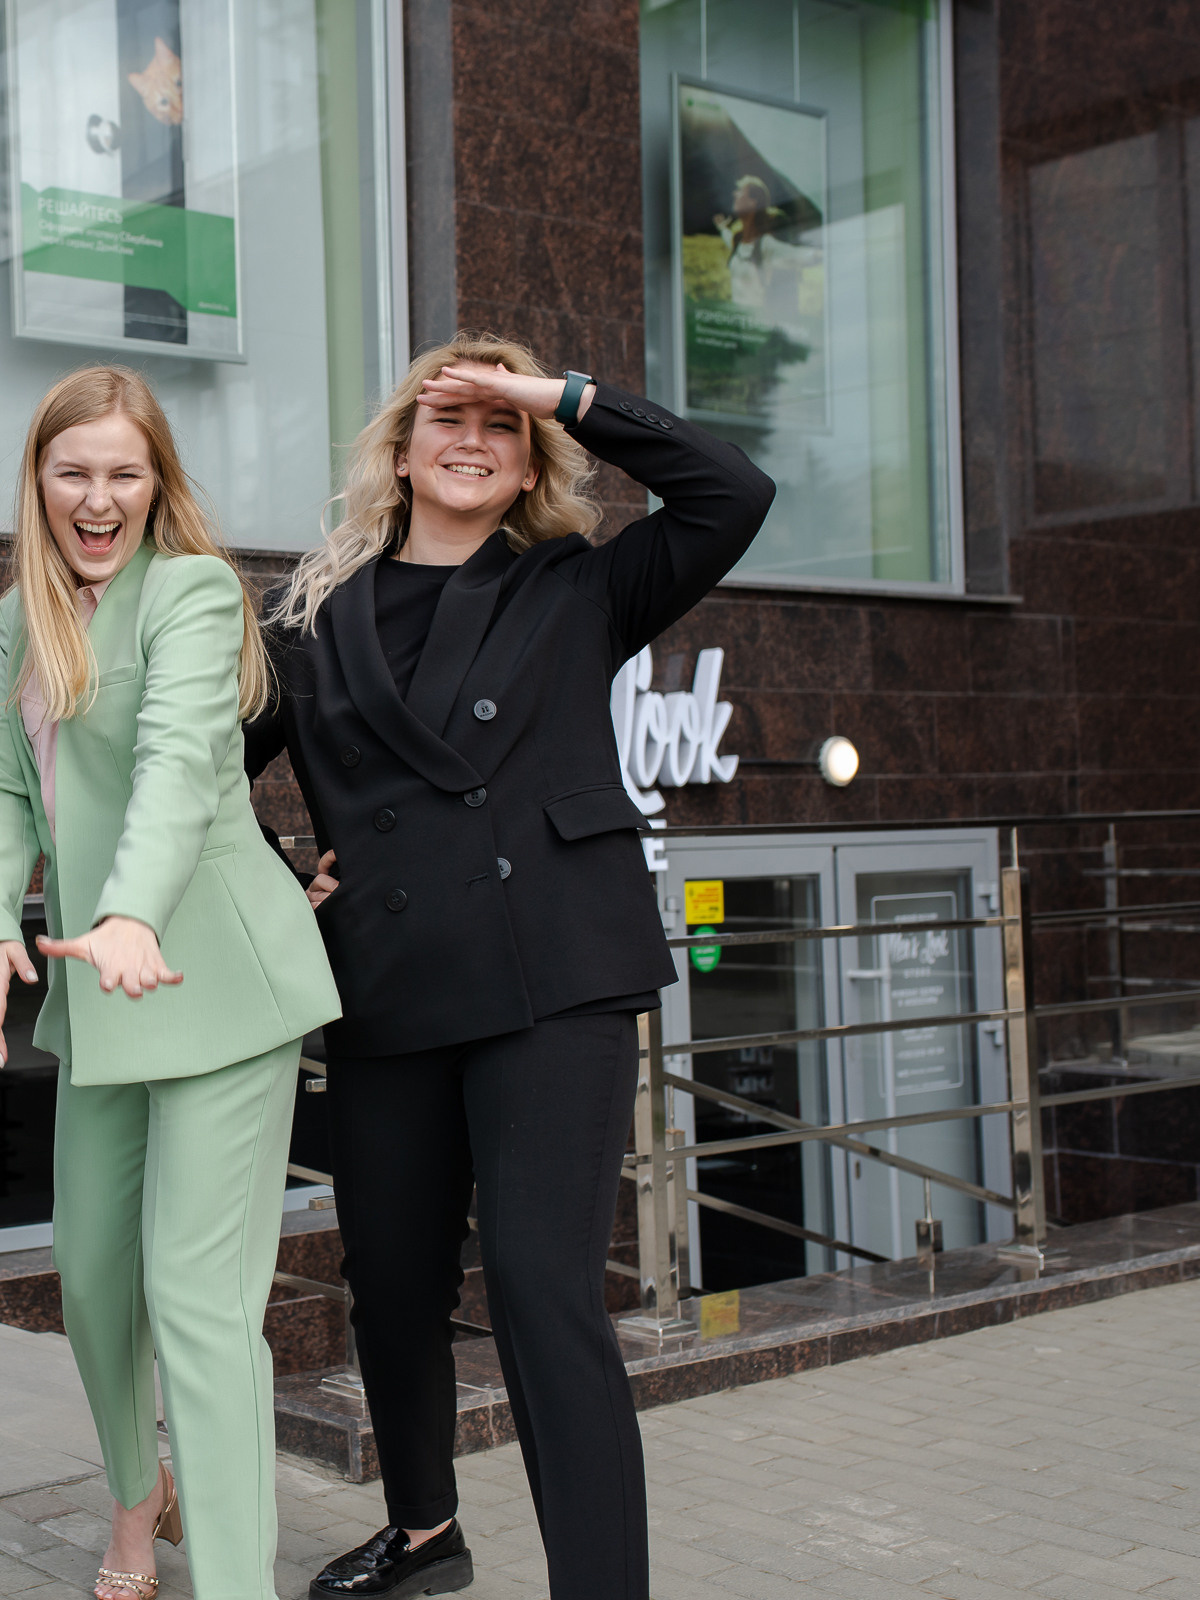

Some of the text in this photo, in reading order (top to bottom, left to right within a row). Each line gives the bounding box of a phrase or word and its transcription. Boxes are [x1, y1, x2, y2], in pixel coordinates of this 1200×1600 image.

[37, 197, 123, 224] РЕШАЙТЕСЬ
[66, 238, 94, 250] сервис
[120, 230, 164, 248] Сбербанка
